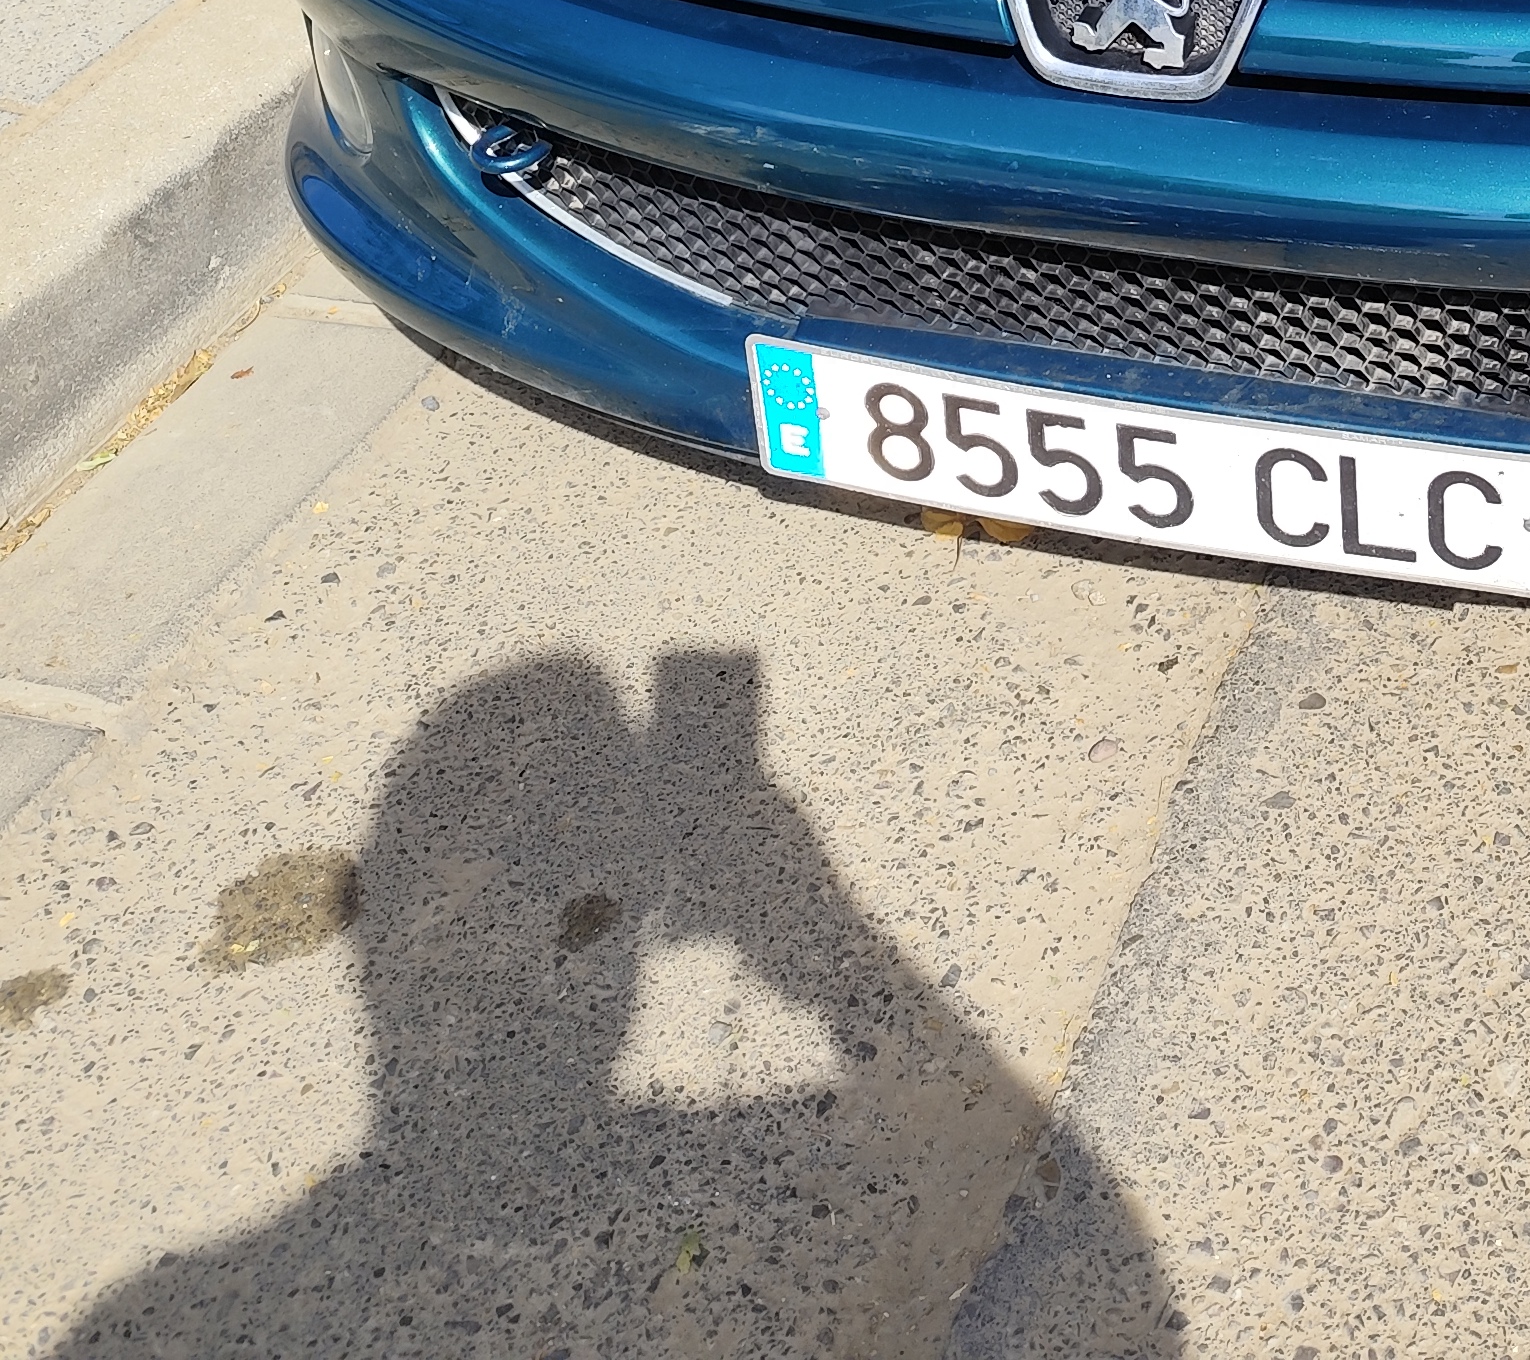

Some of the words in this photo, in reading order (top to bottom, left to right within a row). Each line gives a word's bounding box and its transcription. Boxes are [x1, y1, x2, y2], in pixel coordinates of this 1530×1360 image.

[779, 423, 811, 458] E
[865, 382, 1194, 528] 8555
[1255, 448, 1503, 570] CLC
